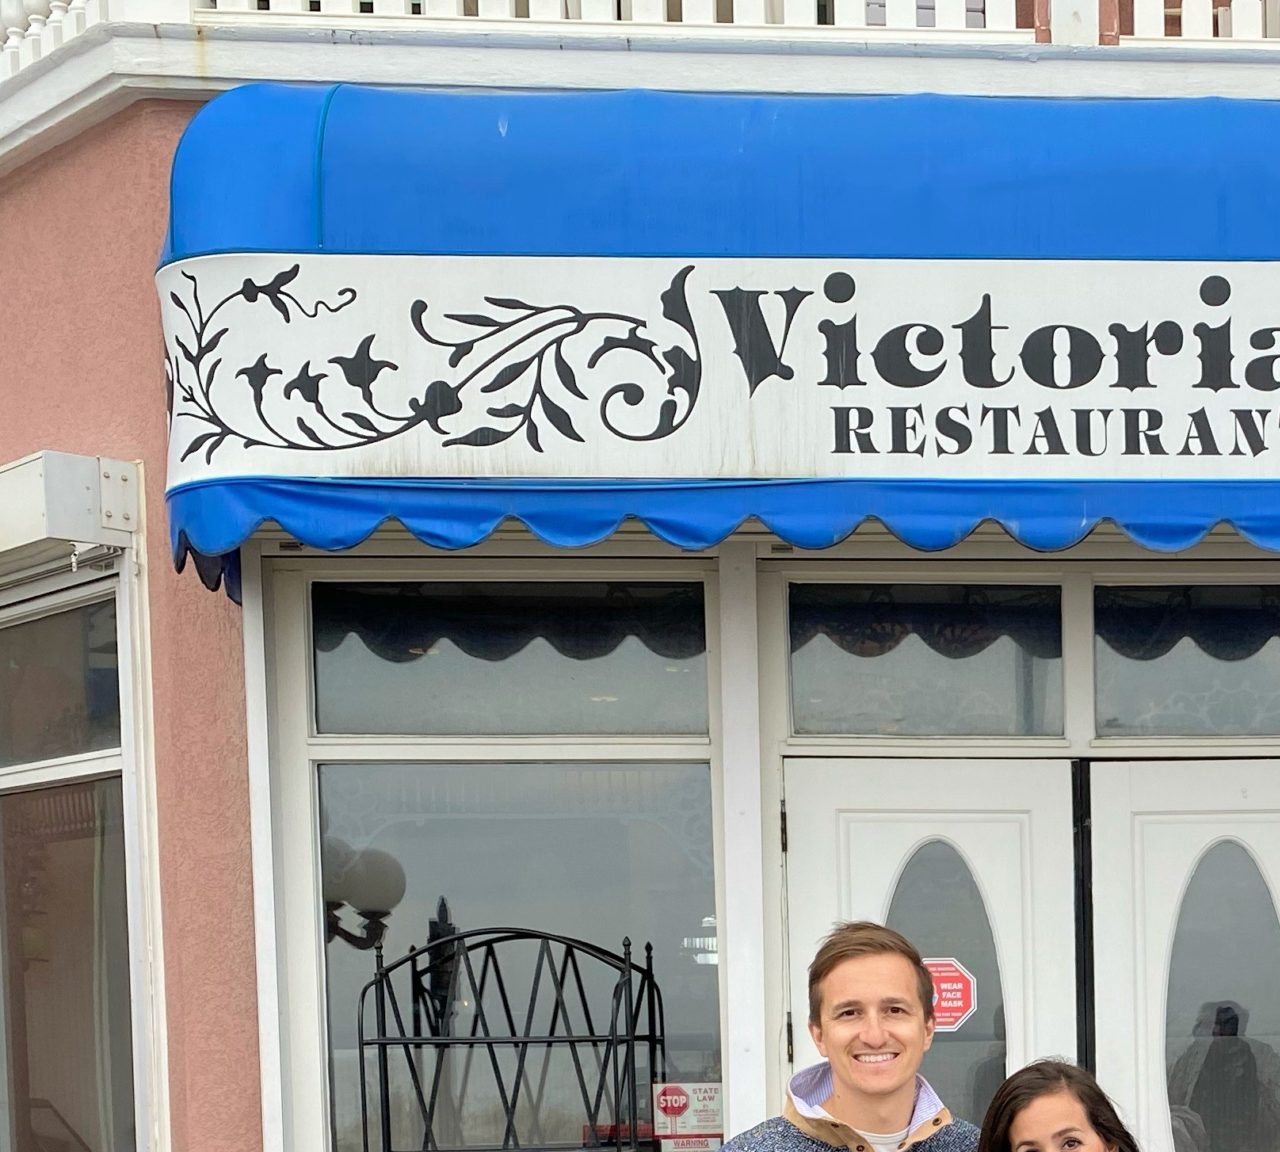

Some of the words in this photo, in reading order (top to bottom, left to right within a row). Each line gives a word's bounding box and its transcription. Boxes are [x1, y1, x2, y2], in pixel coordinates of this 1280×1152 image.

[940, 982, 963, 990] WEAR
[692, 1087, 719, 1095] STATE
[660, 1095, 687, 1108] STOP
[673, 1139, 709, 1147] WARNING
